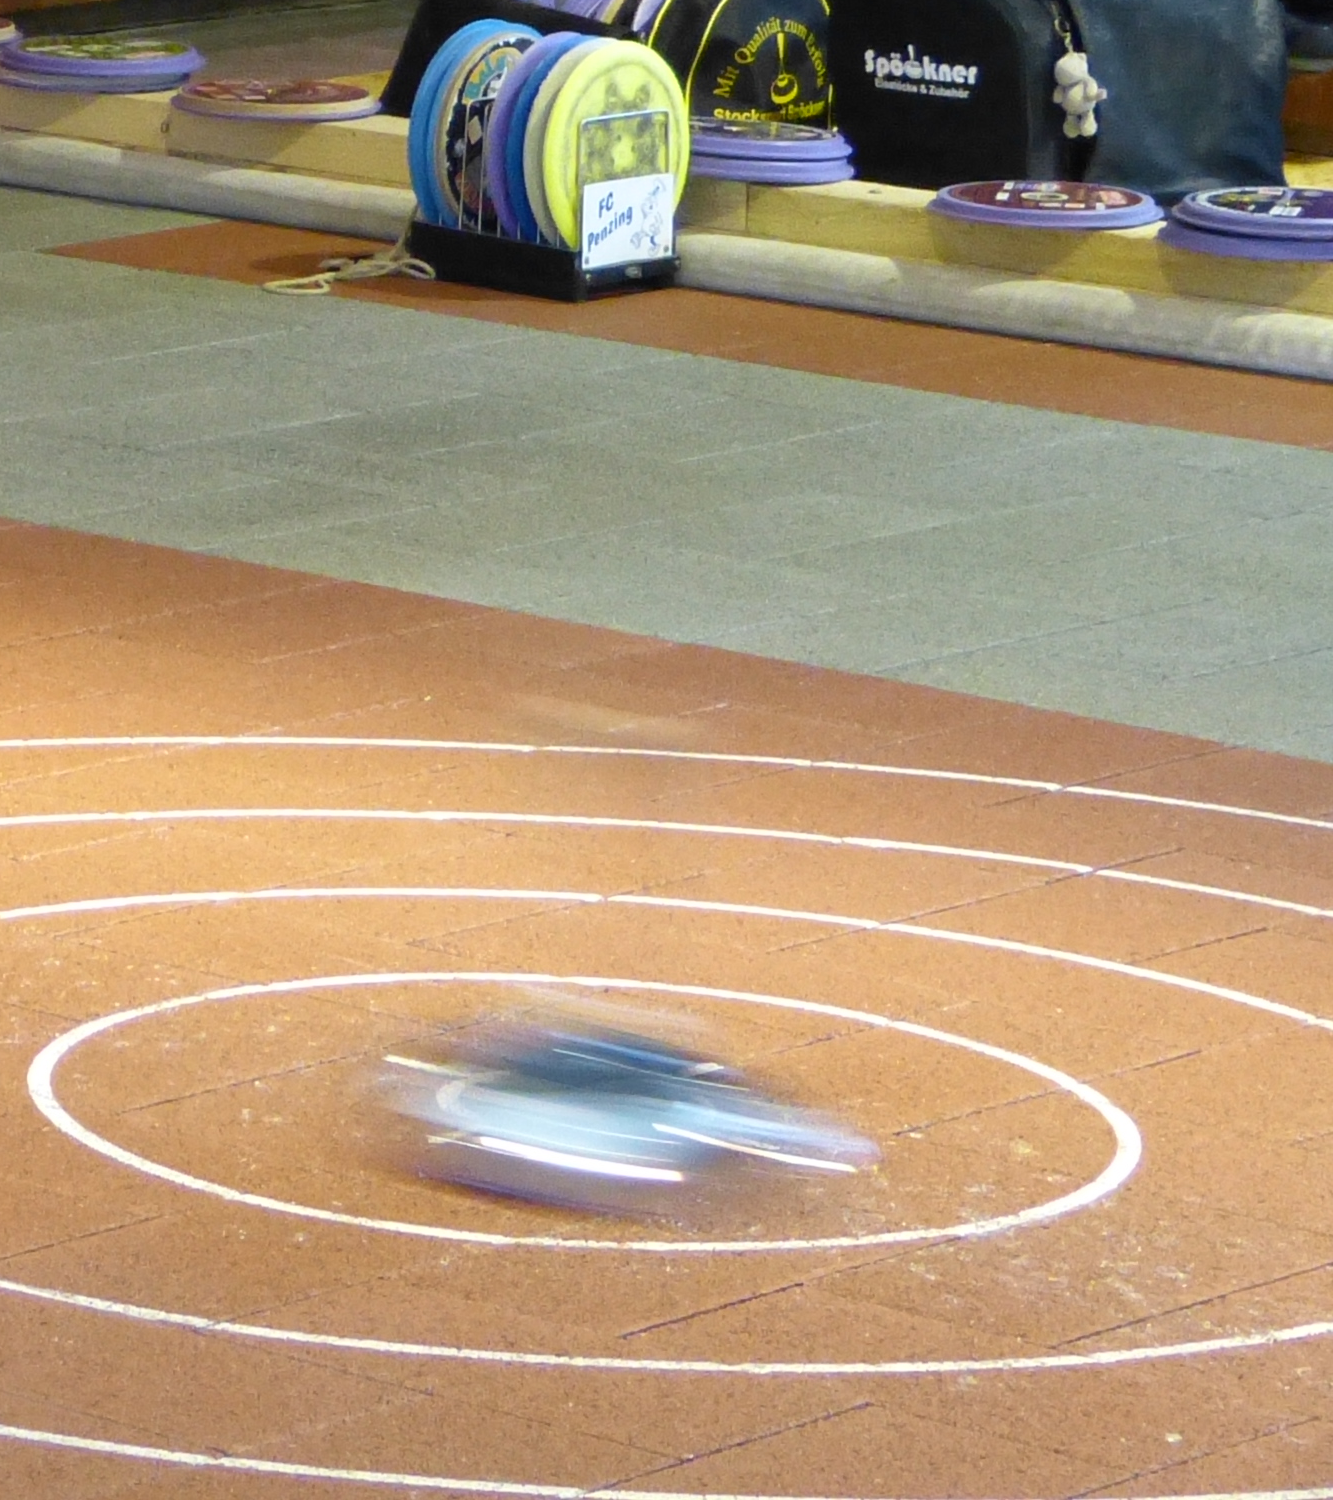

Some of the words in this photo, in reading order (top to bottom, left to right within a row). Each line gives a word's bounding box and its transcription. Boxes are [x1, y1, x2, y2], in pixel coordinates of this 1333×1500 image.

[713, 66, 739, 98] Mit
[735, 16, 782, 65] Qualität
[784, 18, 808, 42] zum
[920, 84, 928, 94] &
[598, 191, 614, 219] FC
[587, 206, 633, 253] Penzing
